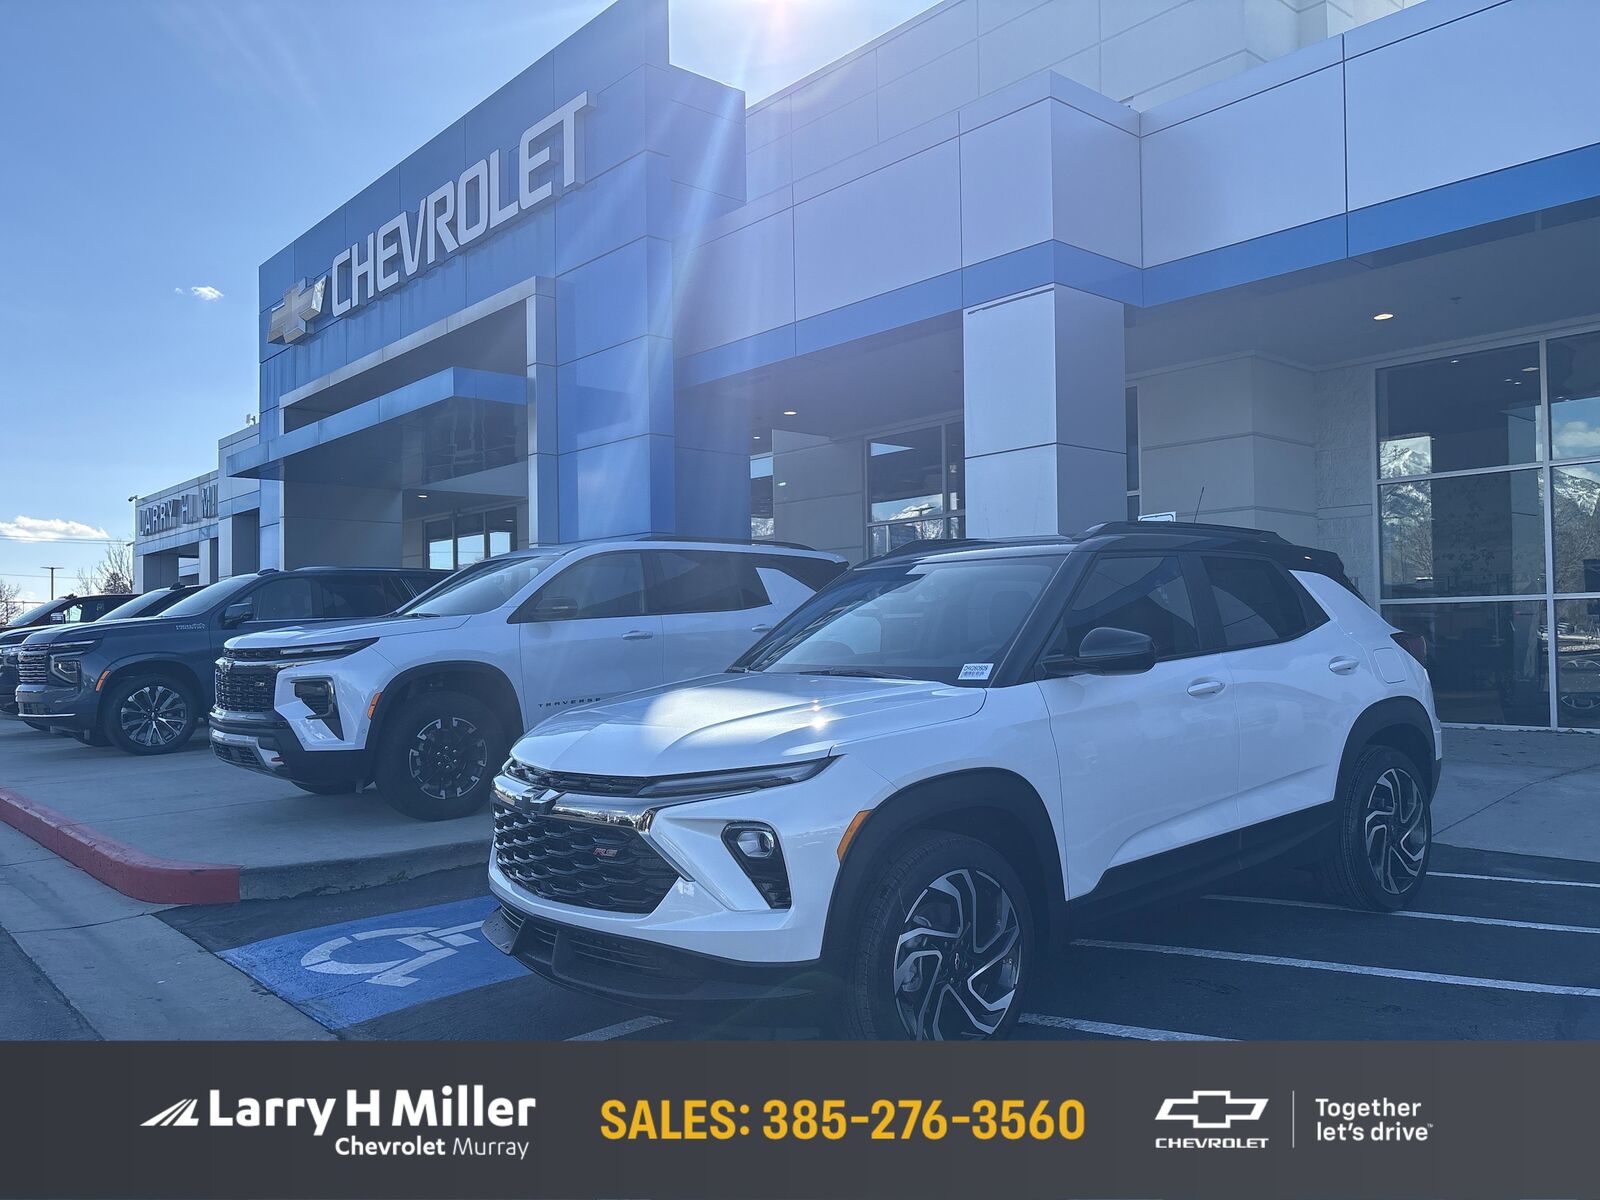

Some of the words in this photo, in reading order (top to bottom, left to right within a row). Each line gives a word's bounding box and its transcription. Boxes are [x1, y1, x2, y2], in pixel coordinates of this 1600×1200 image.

[331, 91, 590, 318] CHEVROLET
[139, 498, 177, 536] LARRY
[538, 697, 602, 708] TRAVERSE
[592, 847, 618, 857] RS
